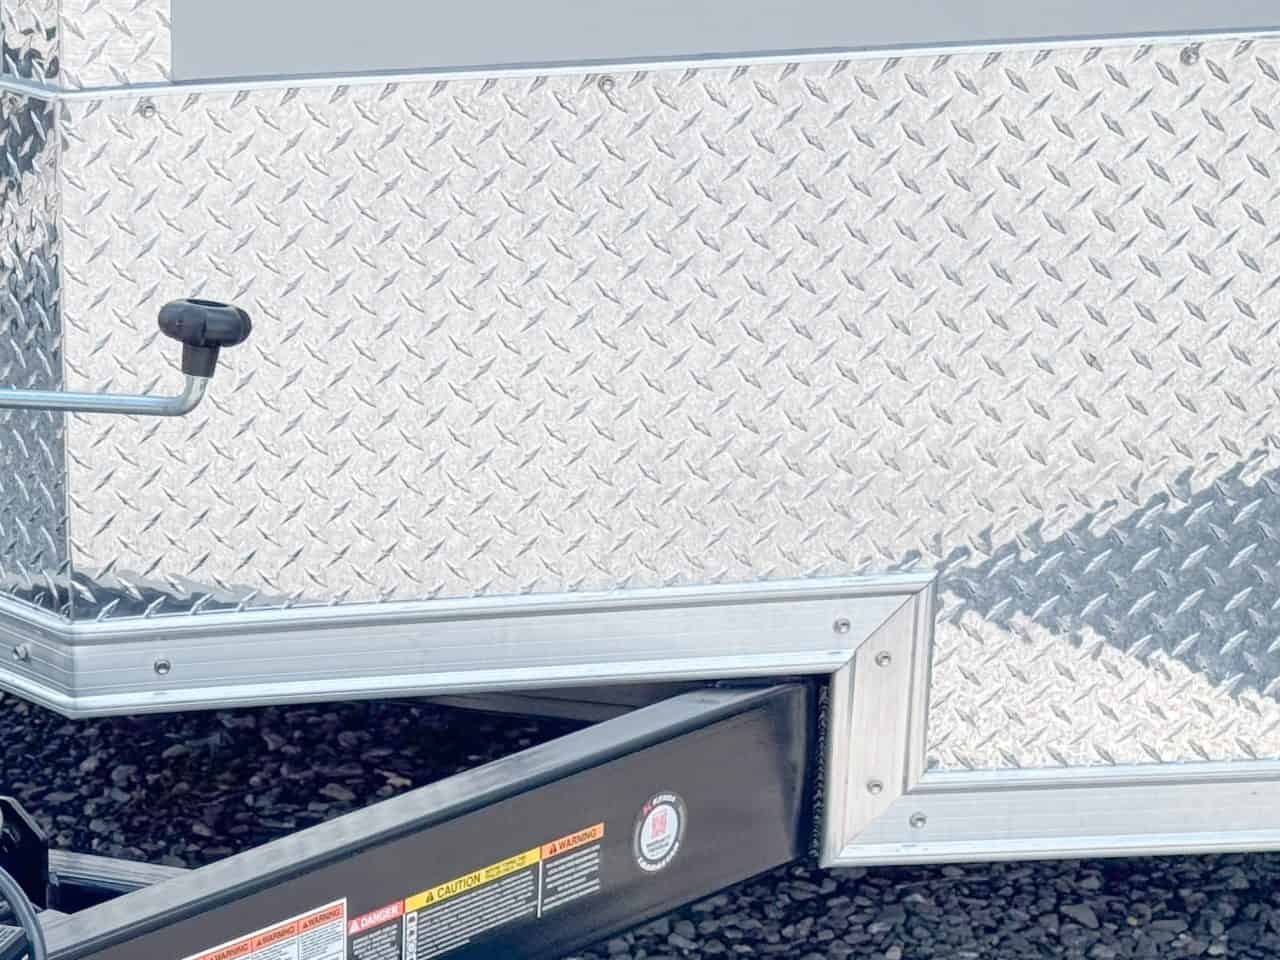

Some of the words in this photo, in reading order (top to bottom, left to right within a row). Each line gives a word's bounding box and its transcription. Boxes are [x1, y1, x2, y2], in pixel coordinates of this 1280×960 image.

[559, 830, 597, 850] WARNING
[436, 873, 481, 899] CAUTION
[309, 908, 341, 928] WARNING
[361, 905, 400, 928] DANGER
[262, 926, 296, 945] WARNING
